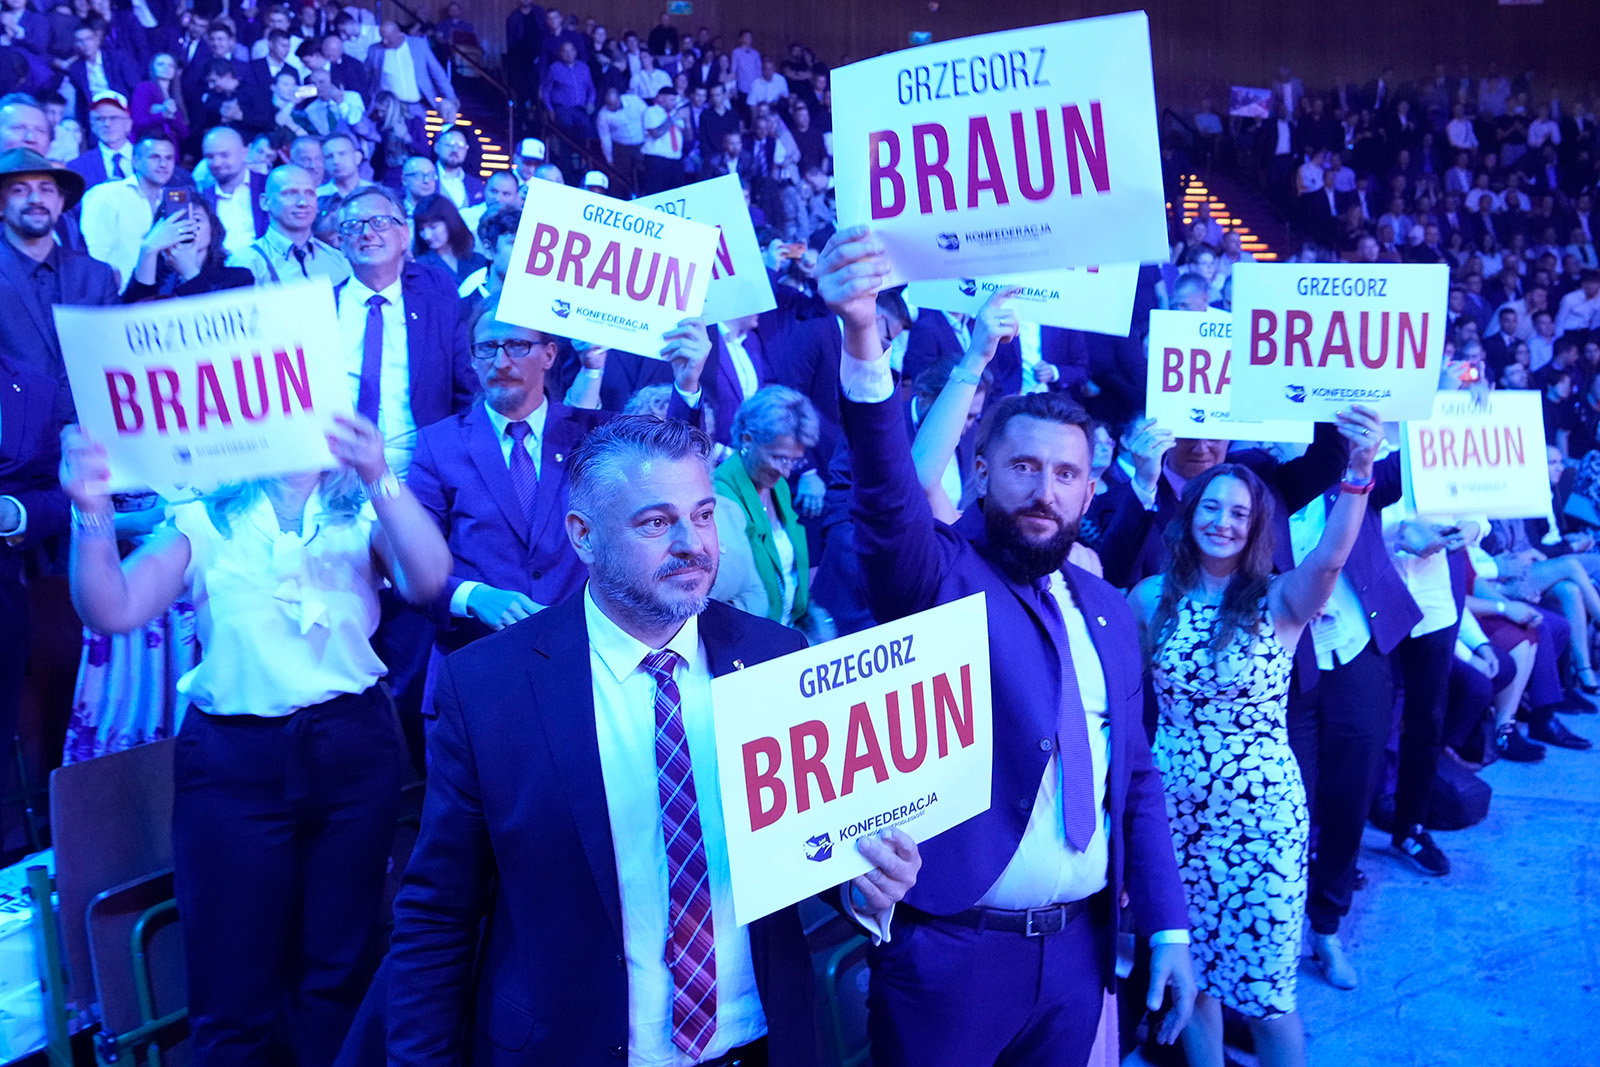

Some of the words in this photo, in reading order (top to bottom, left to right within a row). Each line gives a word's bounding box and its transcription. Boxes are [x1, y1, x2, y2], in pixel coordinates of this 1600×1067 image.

[897, 46, 1051, 105] GRZEGORZ
[868, 98, 1111, 220] BRAUN
[583, 204, 665, 239] GRZEGORZ
[965, 222, 1052, 243] KONFEDERACJA
[524, 222, 697, 312] BRAUN
[1297, 277, 1388, 297] GRZEGORZ
[576, 307, 649, 331] KONFEDERACJA
[1199, 322, 1232, 338] GRZE
[1249, 309, 1430, 370] BRAUN
[103, 343, 313, 438] BRAUN
[1161, 347, 1231, 395] BRA
[1311, 387, 1392, 399] KONFEDERACJA
[1419, 425, 1526, 468] BRAUN
[799, 634, 916, 698] GRZEGORZ
[741, 663, 974, 833] BRAUN
[839, 792, 938, 842] KONFEDERACJA
